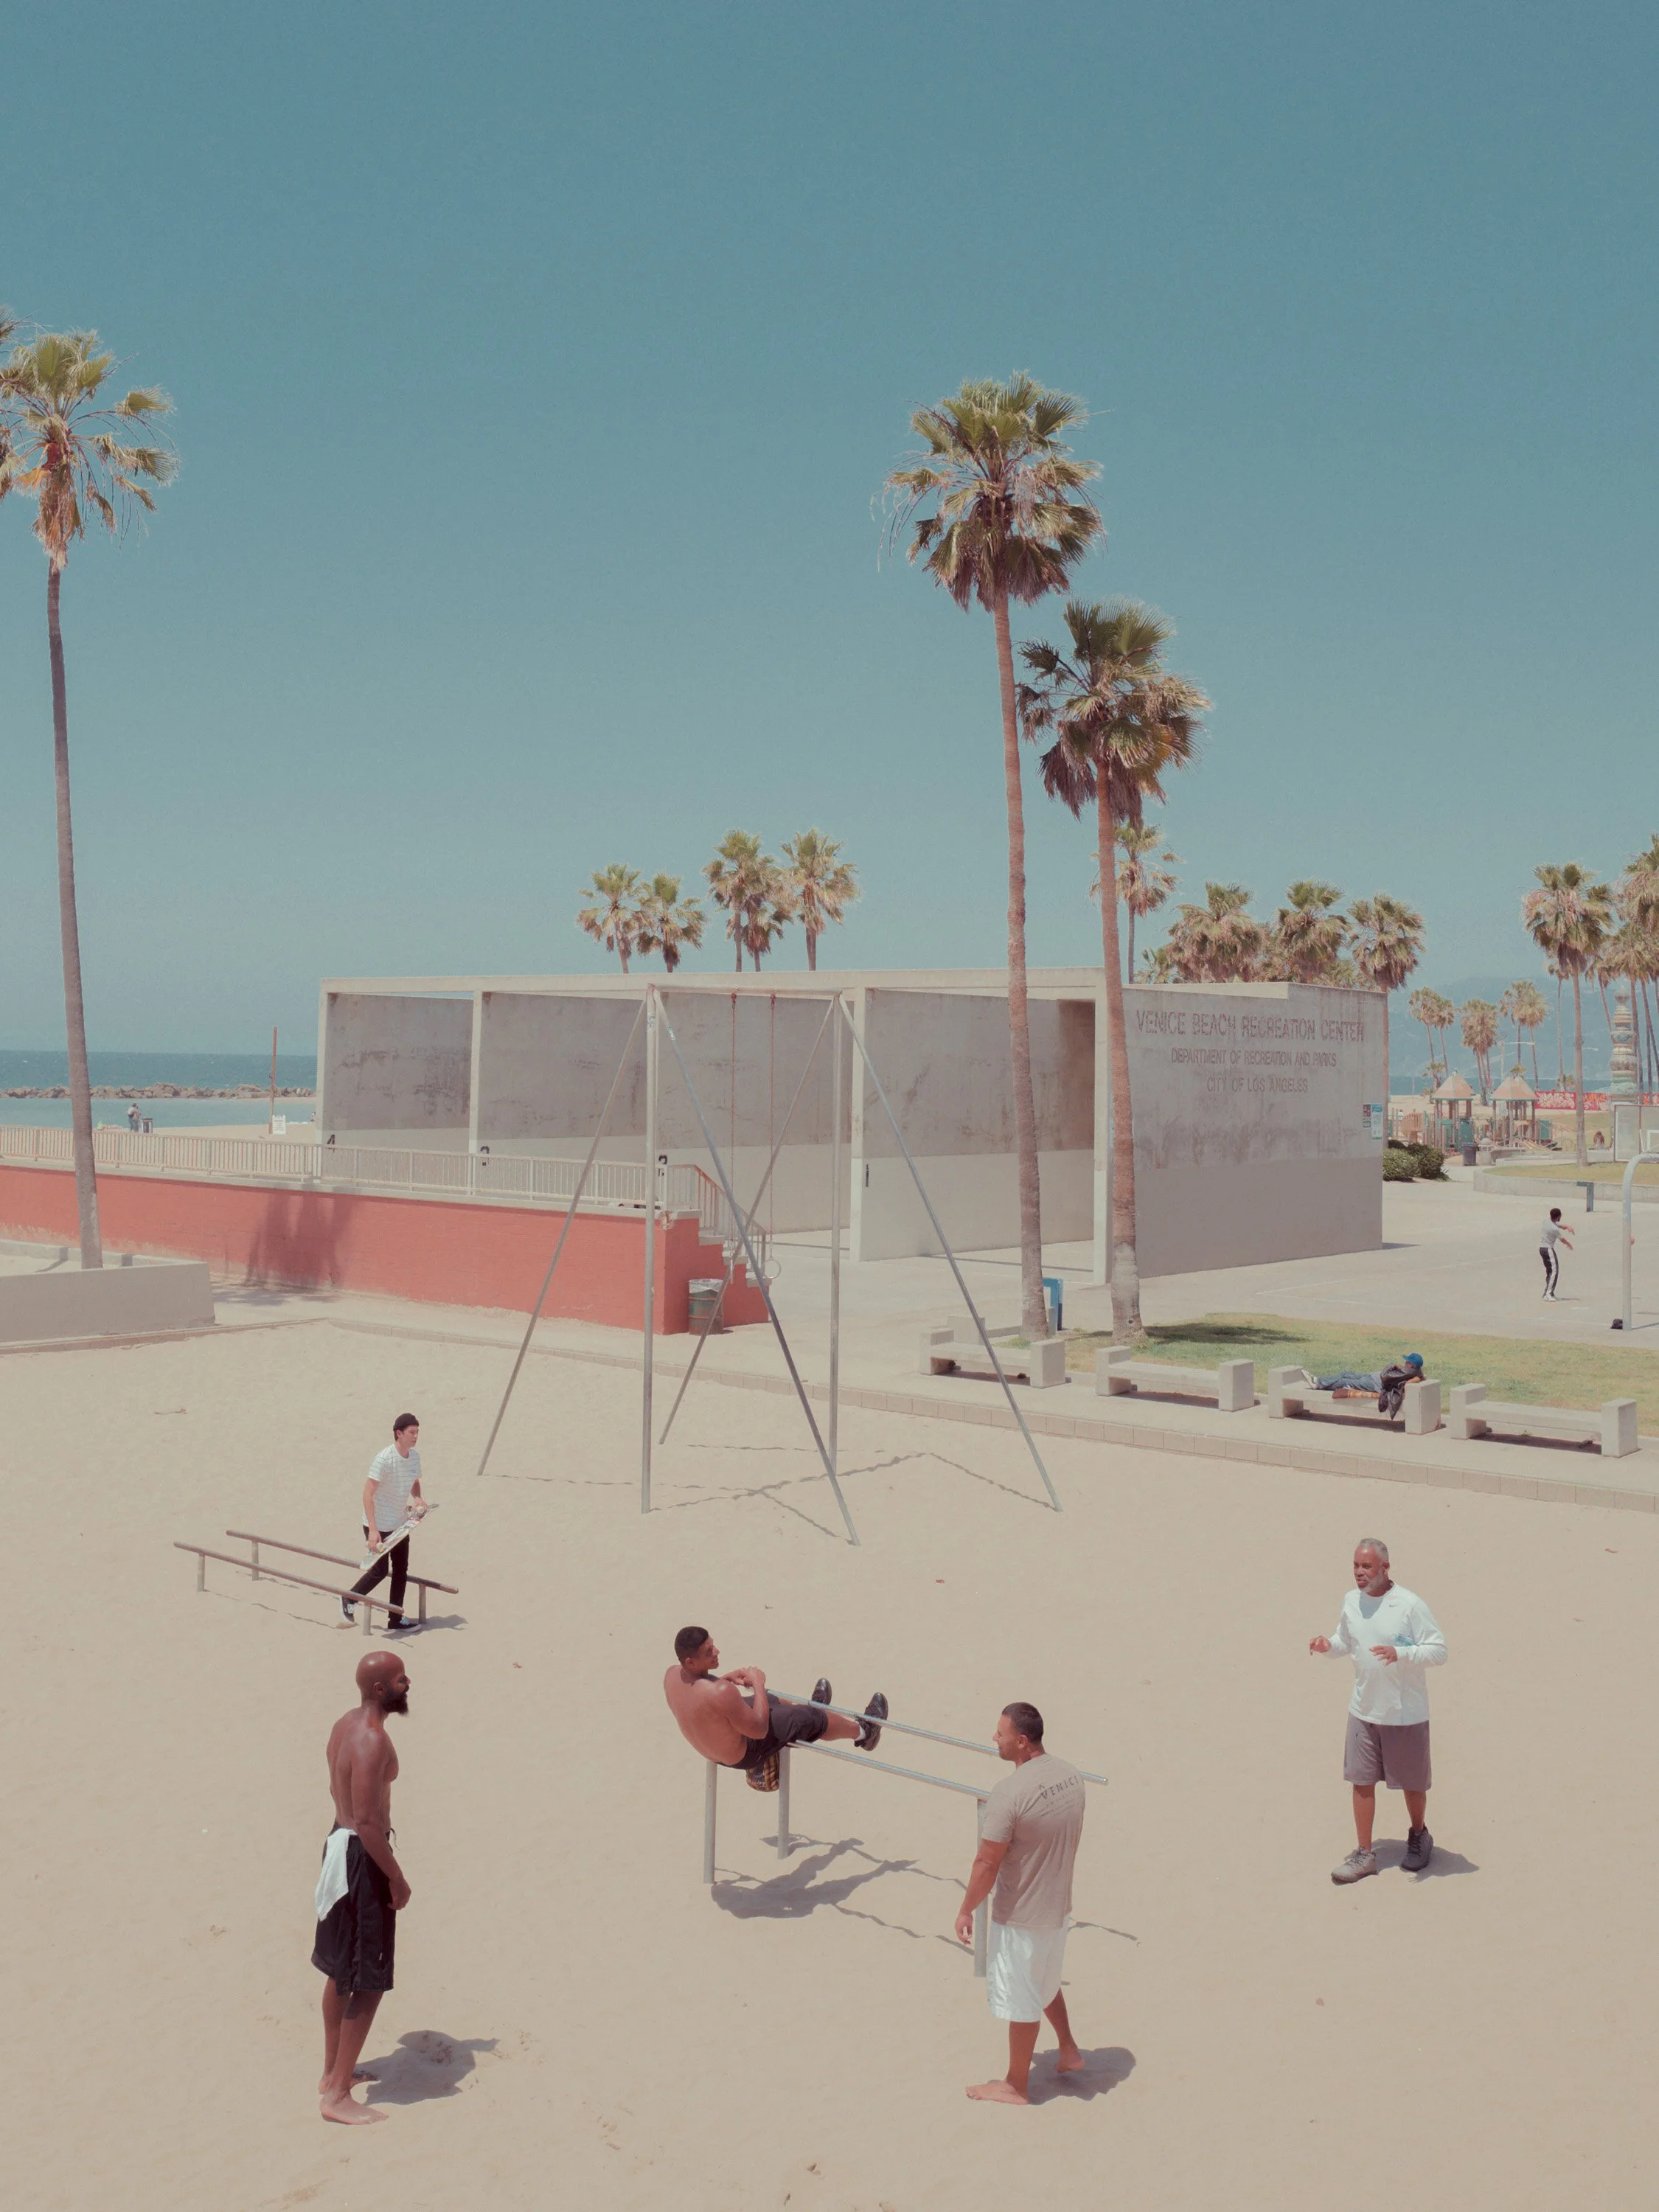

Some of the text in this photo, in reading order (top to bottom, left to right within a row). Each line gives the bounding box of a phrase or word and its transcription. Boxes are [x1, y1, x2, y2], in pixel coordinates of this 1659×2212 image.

[1135, 1009, 1364, 1042] VENICE BEACH RECREATION CENTER
[1171, 1047, 1336, 1067] DEPARTMENT OF RECREATION AND PARKS
[1207, 1077, 1308, 1093] CITY OF LOS ANGELES
